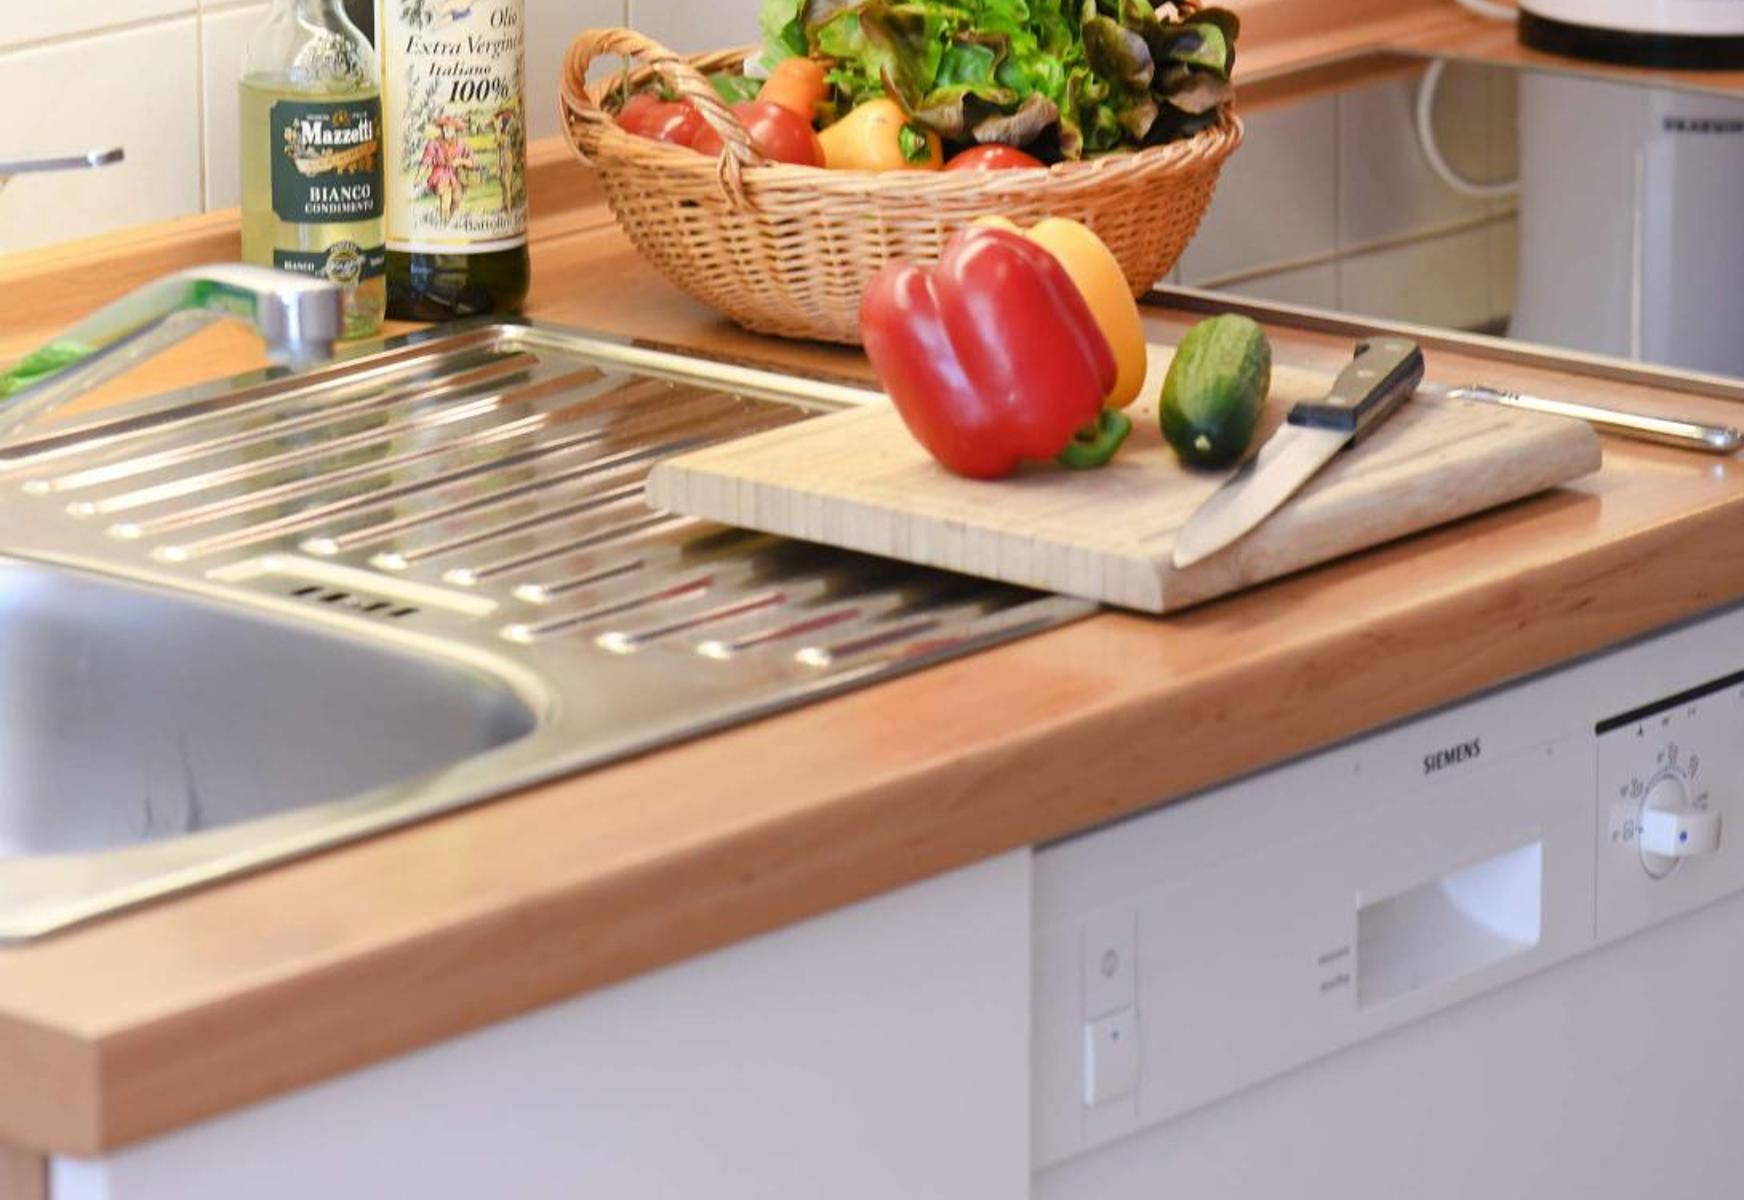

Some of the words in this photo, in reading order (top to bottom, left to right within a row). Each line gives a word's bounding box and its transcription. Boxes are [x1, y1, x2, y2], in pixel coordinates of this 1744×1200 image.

[490, 6, 518, 30] Olio
[406, 35, 462, 55] Extra
[429, 61, 492, 77] Italiano
[448, 76, 510, 104] 100%
[301, 118, 372, 145] Mazzetti
[310, 184, 371, 202] BIANCO
[304, 199, 374, 215] CONDIMENTO
[284, 260, 315, 272] BIANCO
[1423, 736, 1482, 775] SIEMENS
